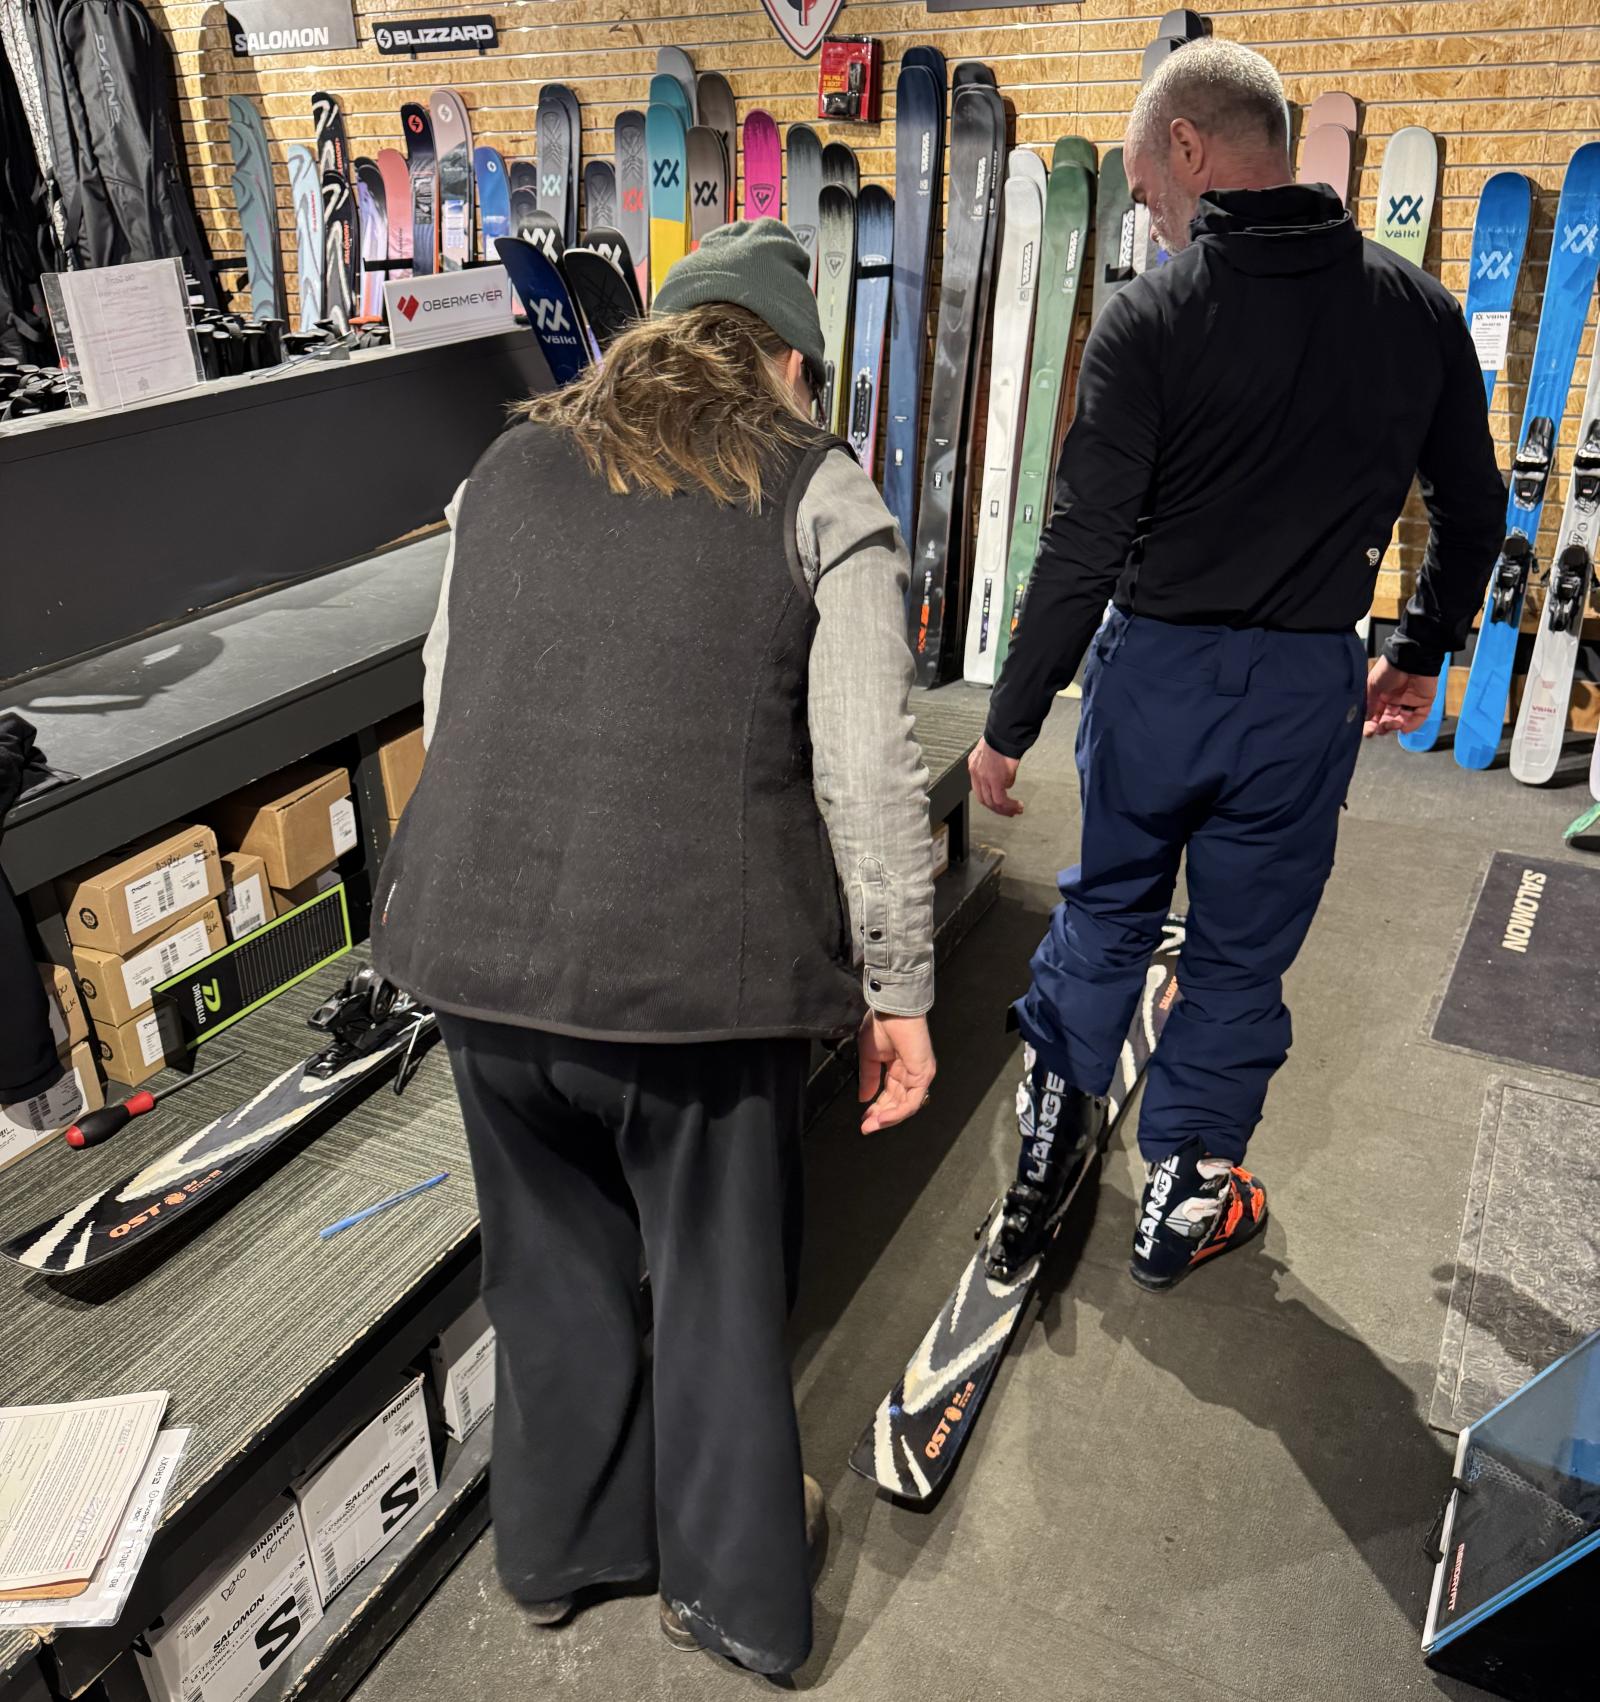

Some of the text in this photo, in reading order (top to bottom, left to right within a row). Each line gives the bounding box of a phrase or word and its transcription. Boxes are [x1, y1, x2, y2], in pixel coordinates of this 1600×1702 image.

[234, 26, 330, 51] SALOMON
[391, 24, 494, 46] BLIZZARD
[1384, 230, 1421, 239] Völkl
[422, 289, 503, 312] OBERMEYER
[541, 334, 578, 345] Völkl
[1502, 869, 1547, 954] SALOMON
[192, 982, 207, 1025] DALBELLO
[1026, 1071, 1067, 1184] LANGE
[109, 1202, 162, 1238] QST
[1134, 1155, 1181, 1261] LANGE
[382, 1385, 421, 1425] BINDINGS
[925, 1417, 951, 1459] QST
[344, 1462, 392, 1510] SALOMON
[248, 1510, 296, 1560] BINDINGS
[220, 1568, 247, 1602] DEMO
[323, 1557, 367, 1603] BINDUNGEN
[212, 1594, 266, 1653] SALOMON
